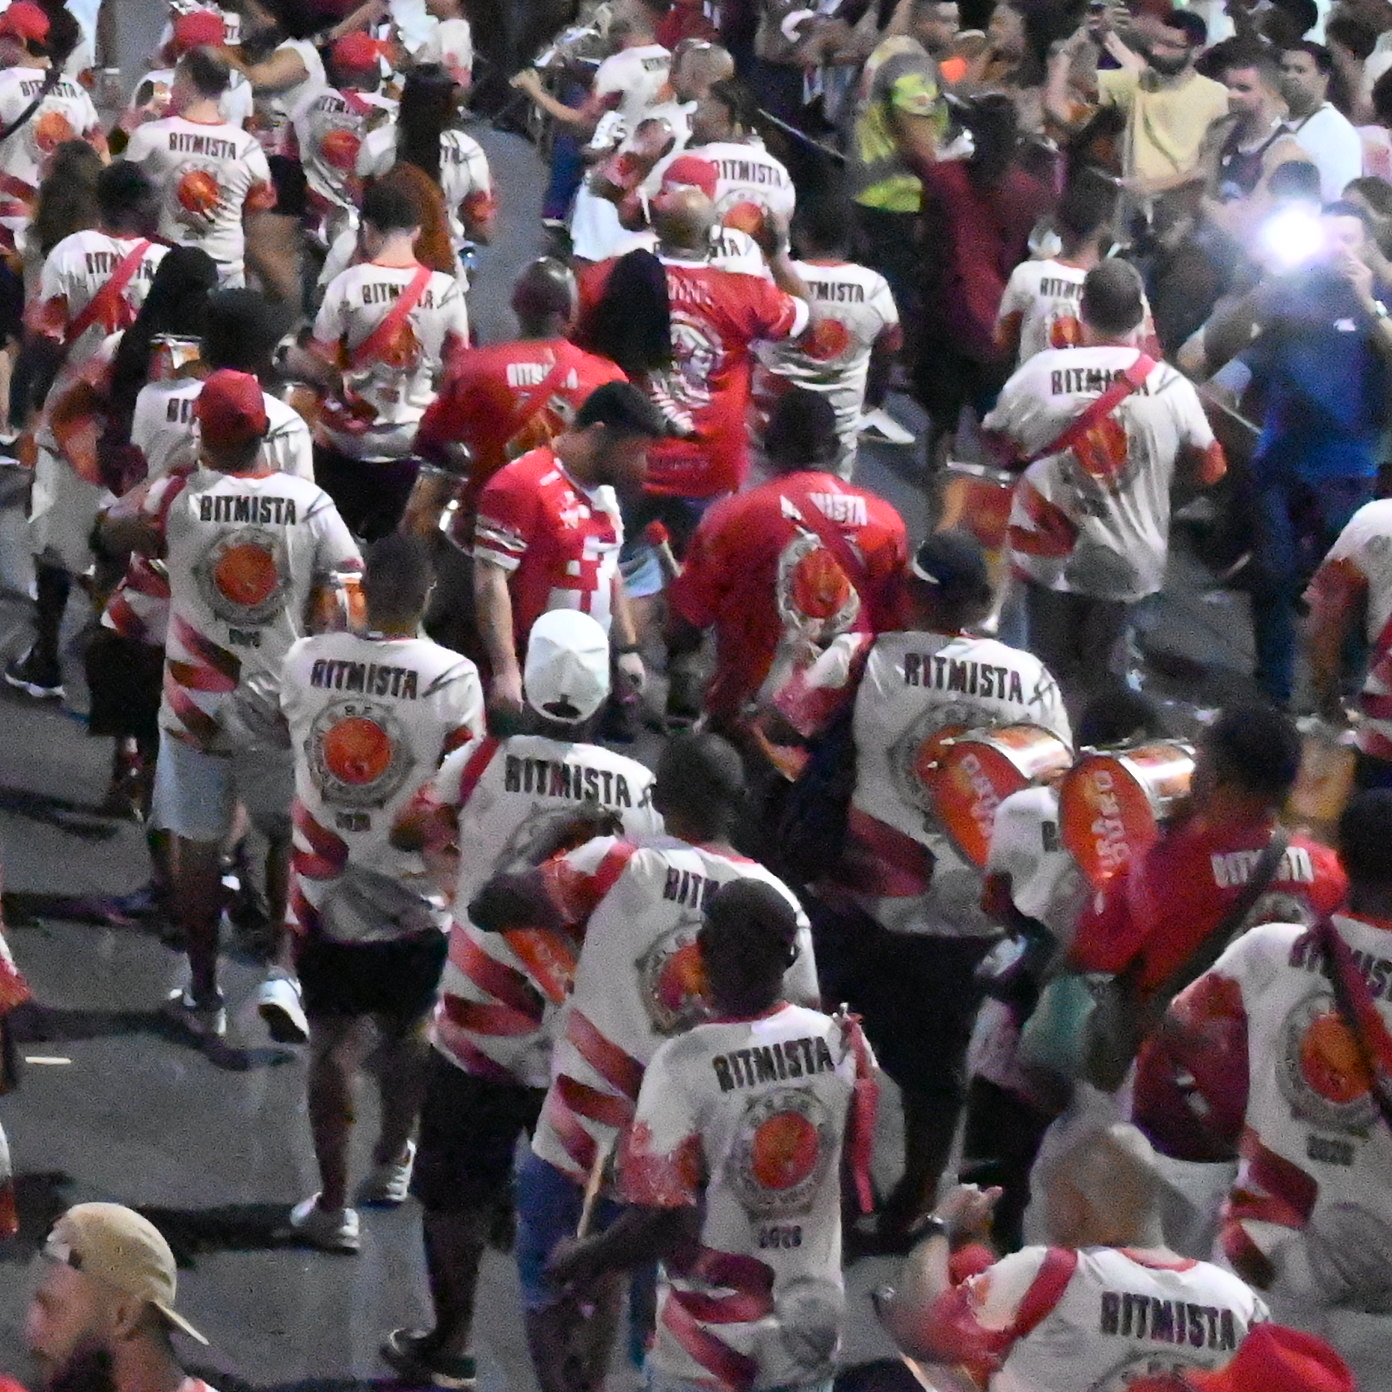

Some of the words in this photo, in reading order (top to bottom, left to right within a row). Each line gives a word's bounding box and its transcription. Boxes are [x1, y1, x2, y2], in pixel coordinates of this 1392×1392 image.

[169, 134, 236, 159] RITMISTA
[201, 496, 295, 525] RITMISTA
[311, 659, 417, 699] RITMISTA
[905, 653, 1022, 703] RITMISTA
[505, 755, 630, 806] RITMISTA
[712, 1036, 834, 1093] RITMISTA
[1102, 1291, 1235, 1350] RITMISTA
